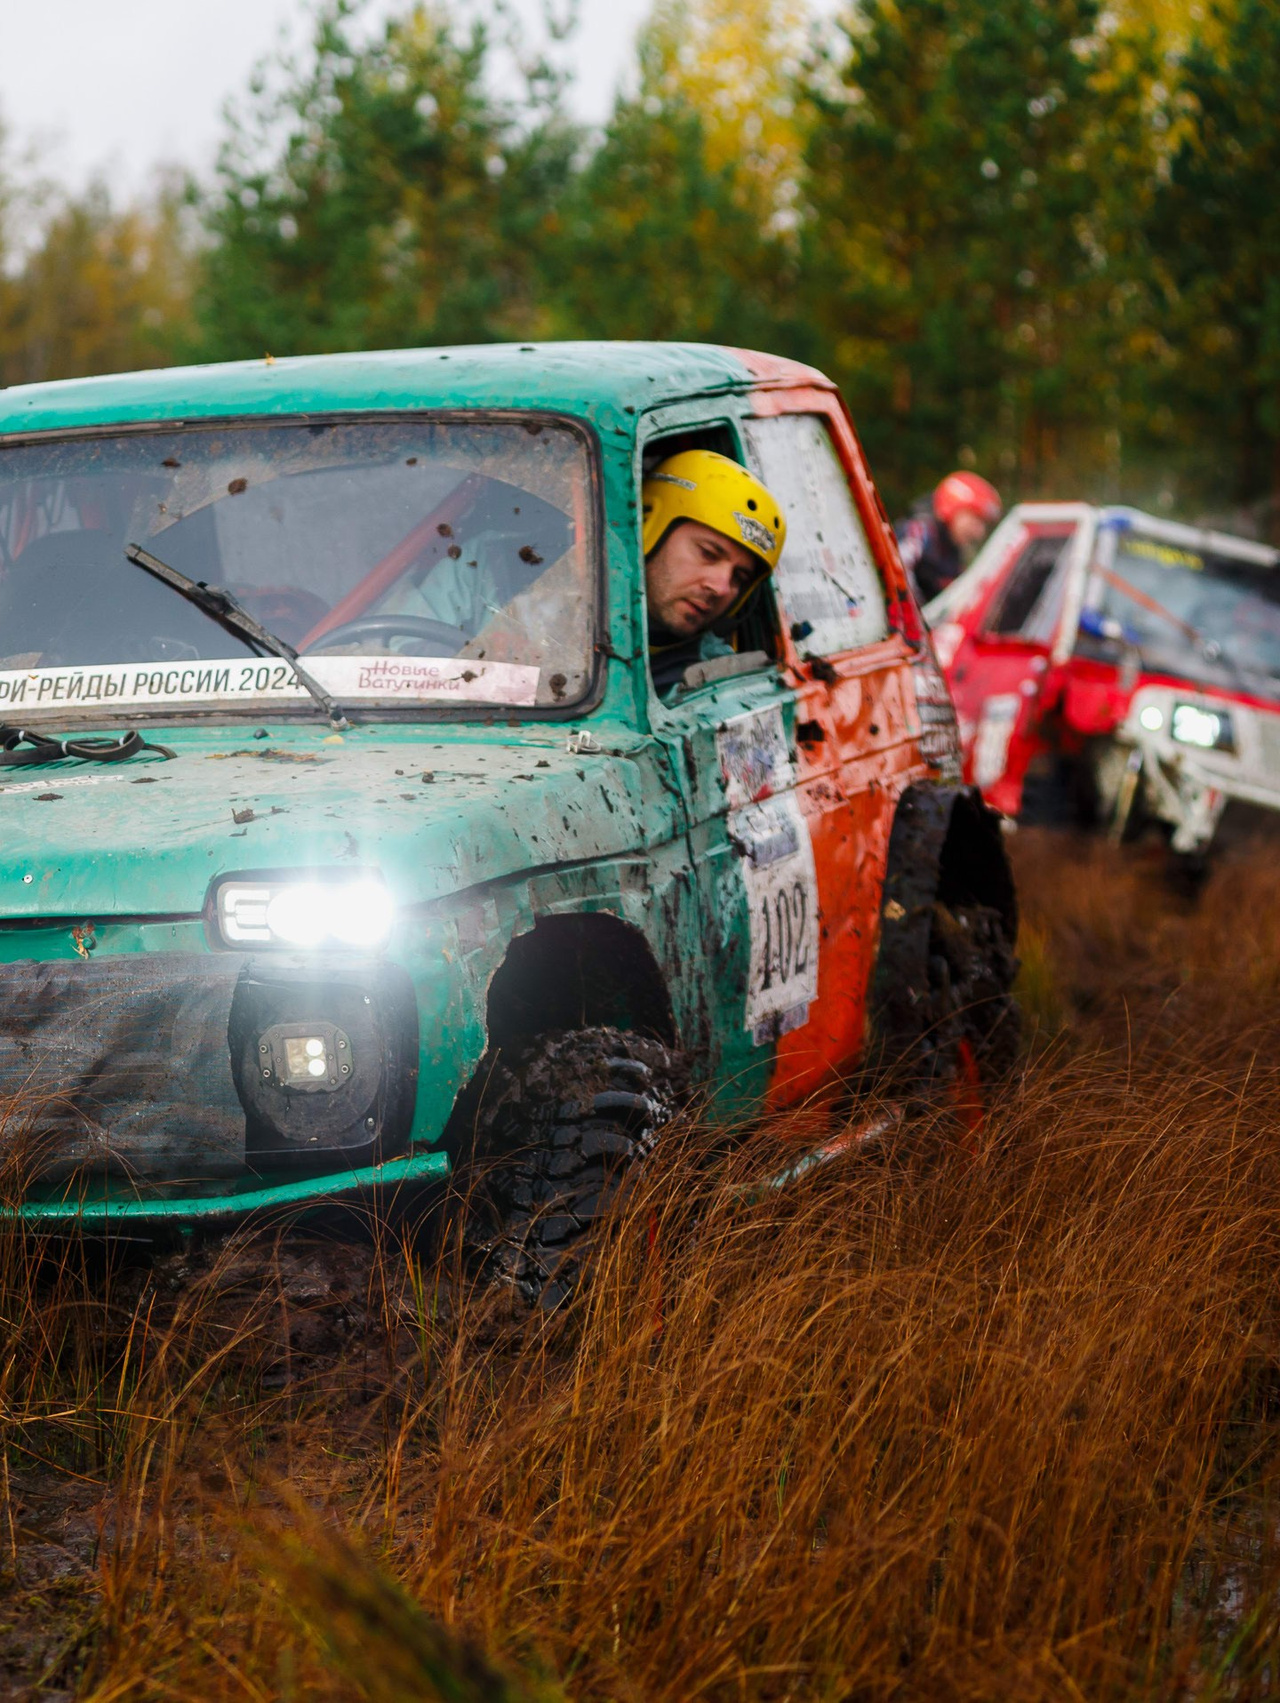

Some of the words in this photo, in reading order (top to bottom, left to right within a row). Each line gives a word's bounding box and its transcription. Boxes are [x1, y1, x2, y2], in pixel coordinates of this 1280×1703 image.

[360, 660, 440, 677] Новые
[358, 671, 460, 692] Ватутинки
[760, 882, 809, 991] 102
